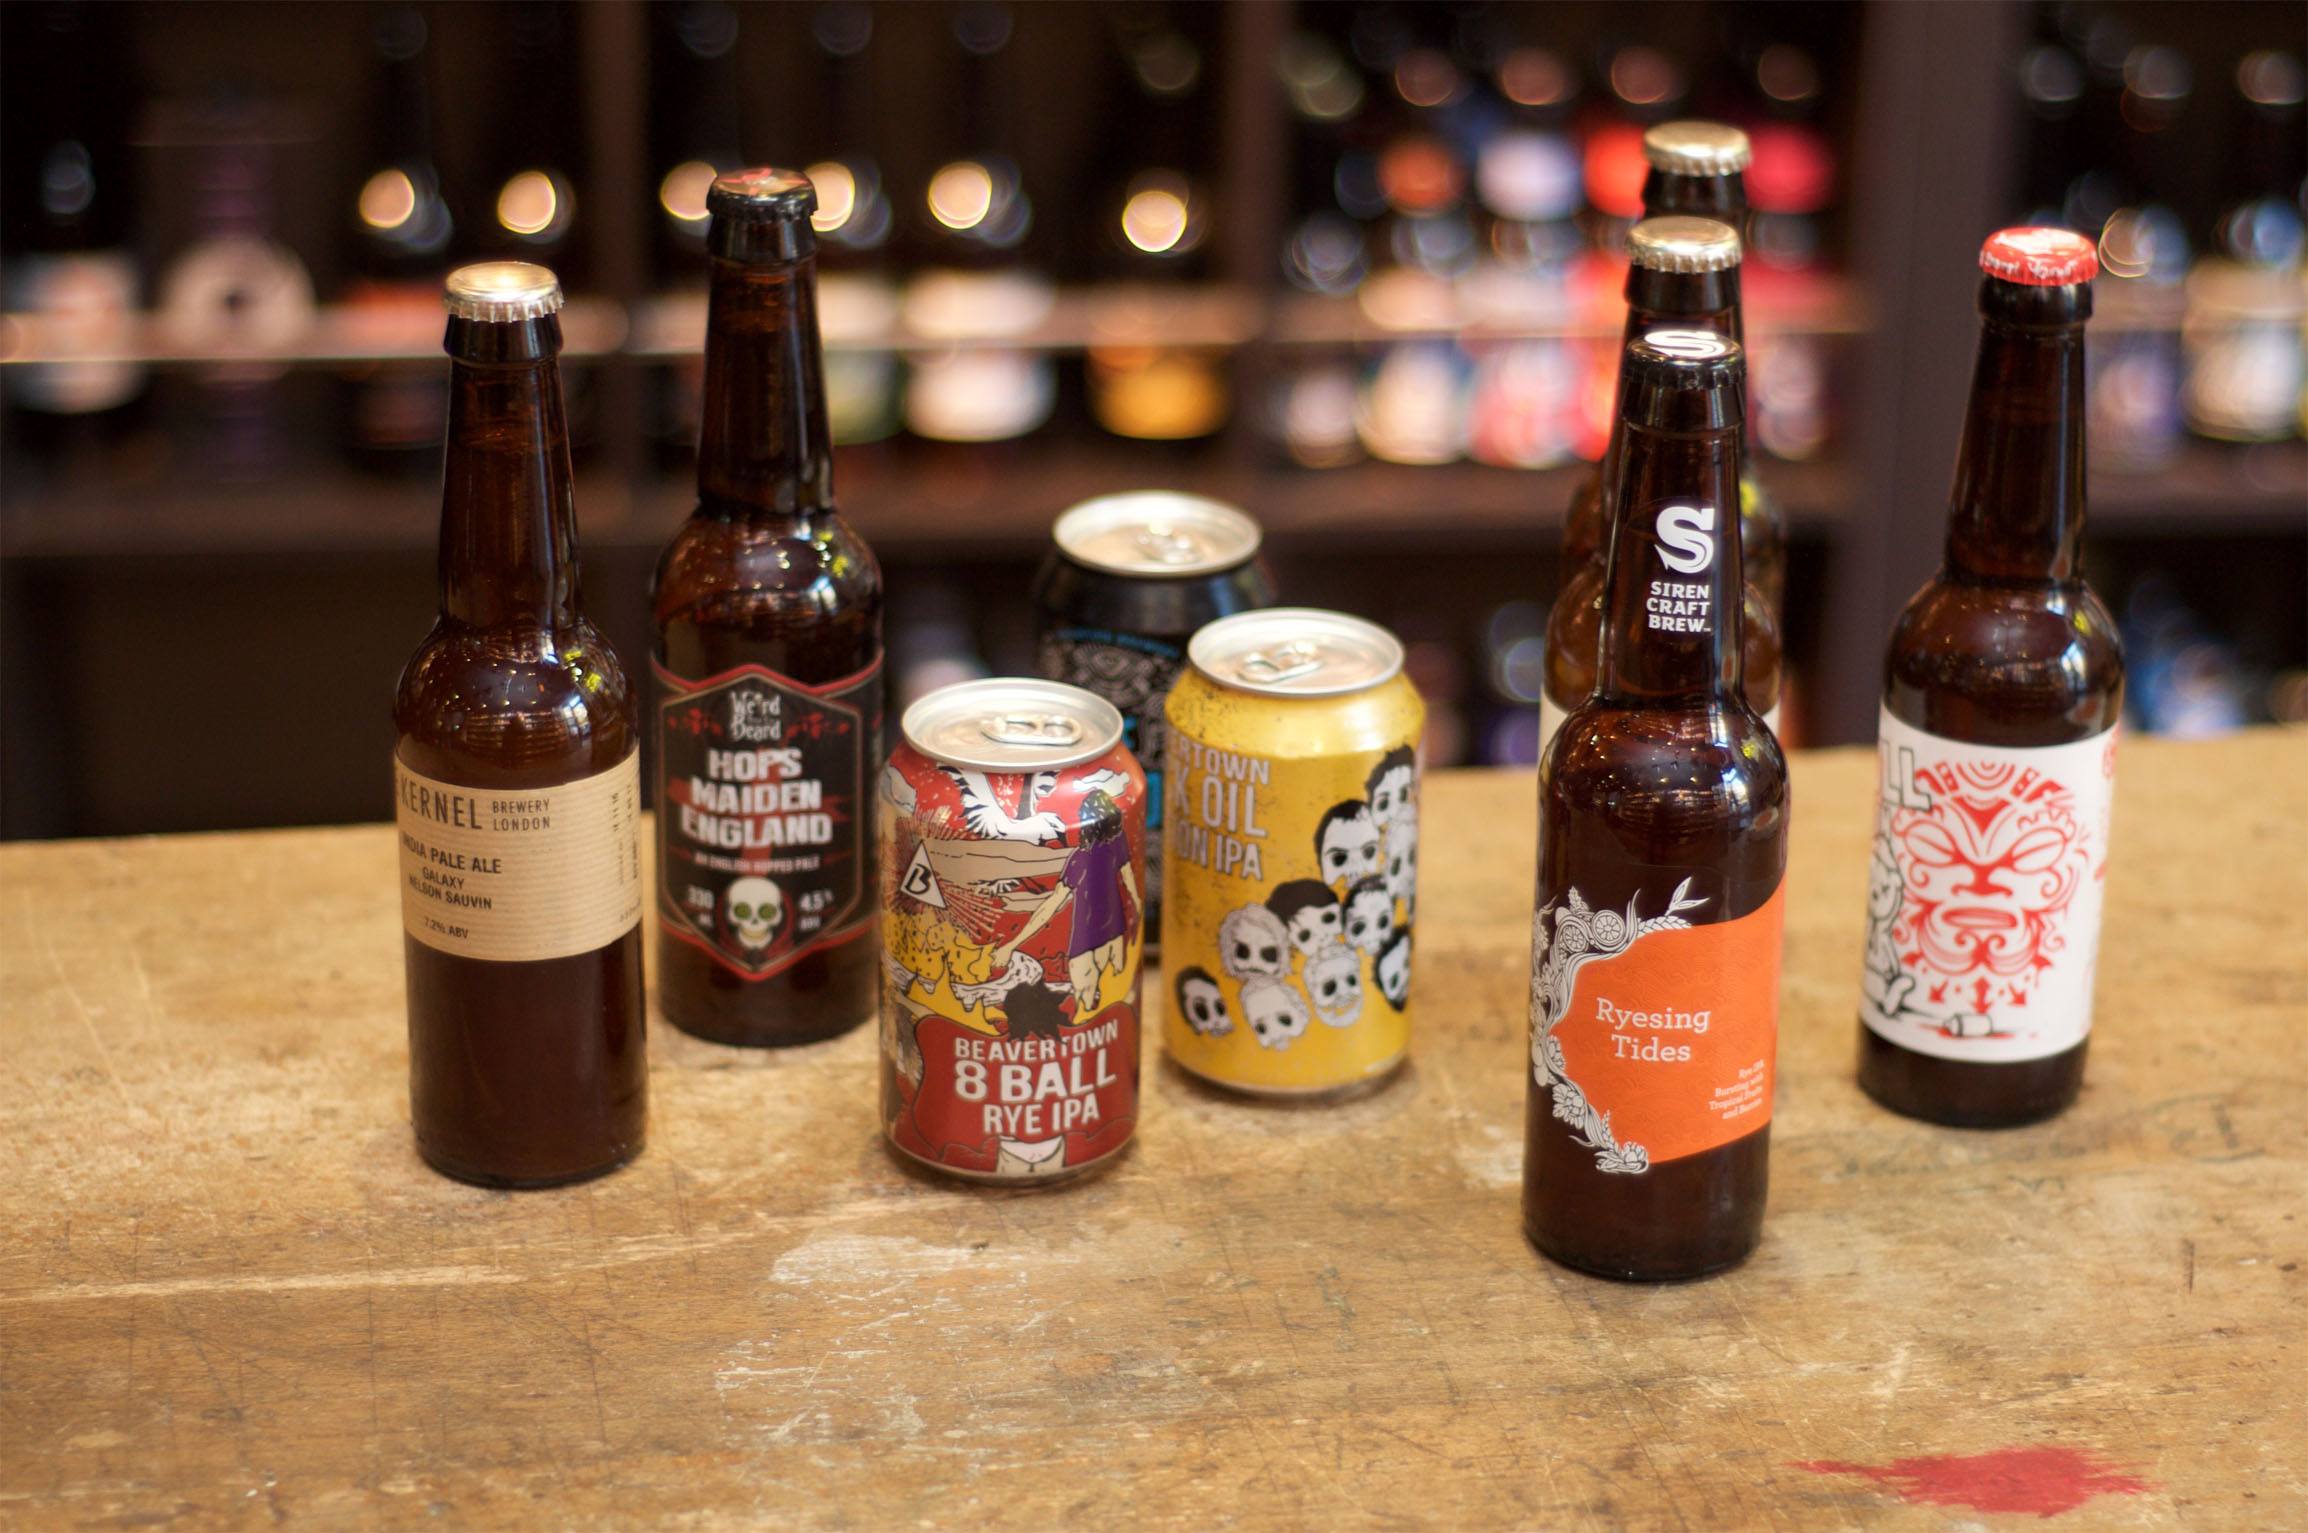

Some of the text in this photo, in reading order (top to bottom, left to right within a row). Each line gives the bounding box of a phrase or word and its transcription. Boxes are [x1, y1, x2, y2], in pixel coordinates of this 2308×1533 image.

[1646, 597, 1710, 616] CRAFT
[1651, 581, 1709, 599] SIREN
[709, 748, 802, 781] HOPS
[400, 777, 483, 830] KERNEL
[492, 798, 550, 814] BREWERY
[690, 776, 822, 814] MAIDEN
[1202, 775, 1267, 838] OIL
[494, 816, 550, 832] LONDON
[681, 804, 833, 848] ENGLAND
[430, 847, 466, 870] PALE
[471, 857, 503, 874] ALE
[1215, 834, 1263, 882] IPA
[422, 866, 465, 890] GALAXY
[445, 890, 493, 910] SAUVIN
[447, 925, 469, 939] ABV
[1595, 997, 1710, 1034] Ryesing
[954, 1018, 1118, 1063] BEAVERTOWN
[1611, 1033, 1691, 1062] Tides
[954, 1048, 1117, 1103] 8 BALL
[983, 1092, 1100, 1135] RYE IPA
